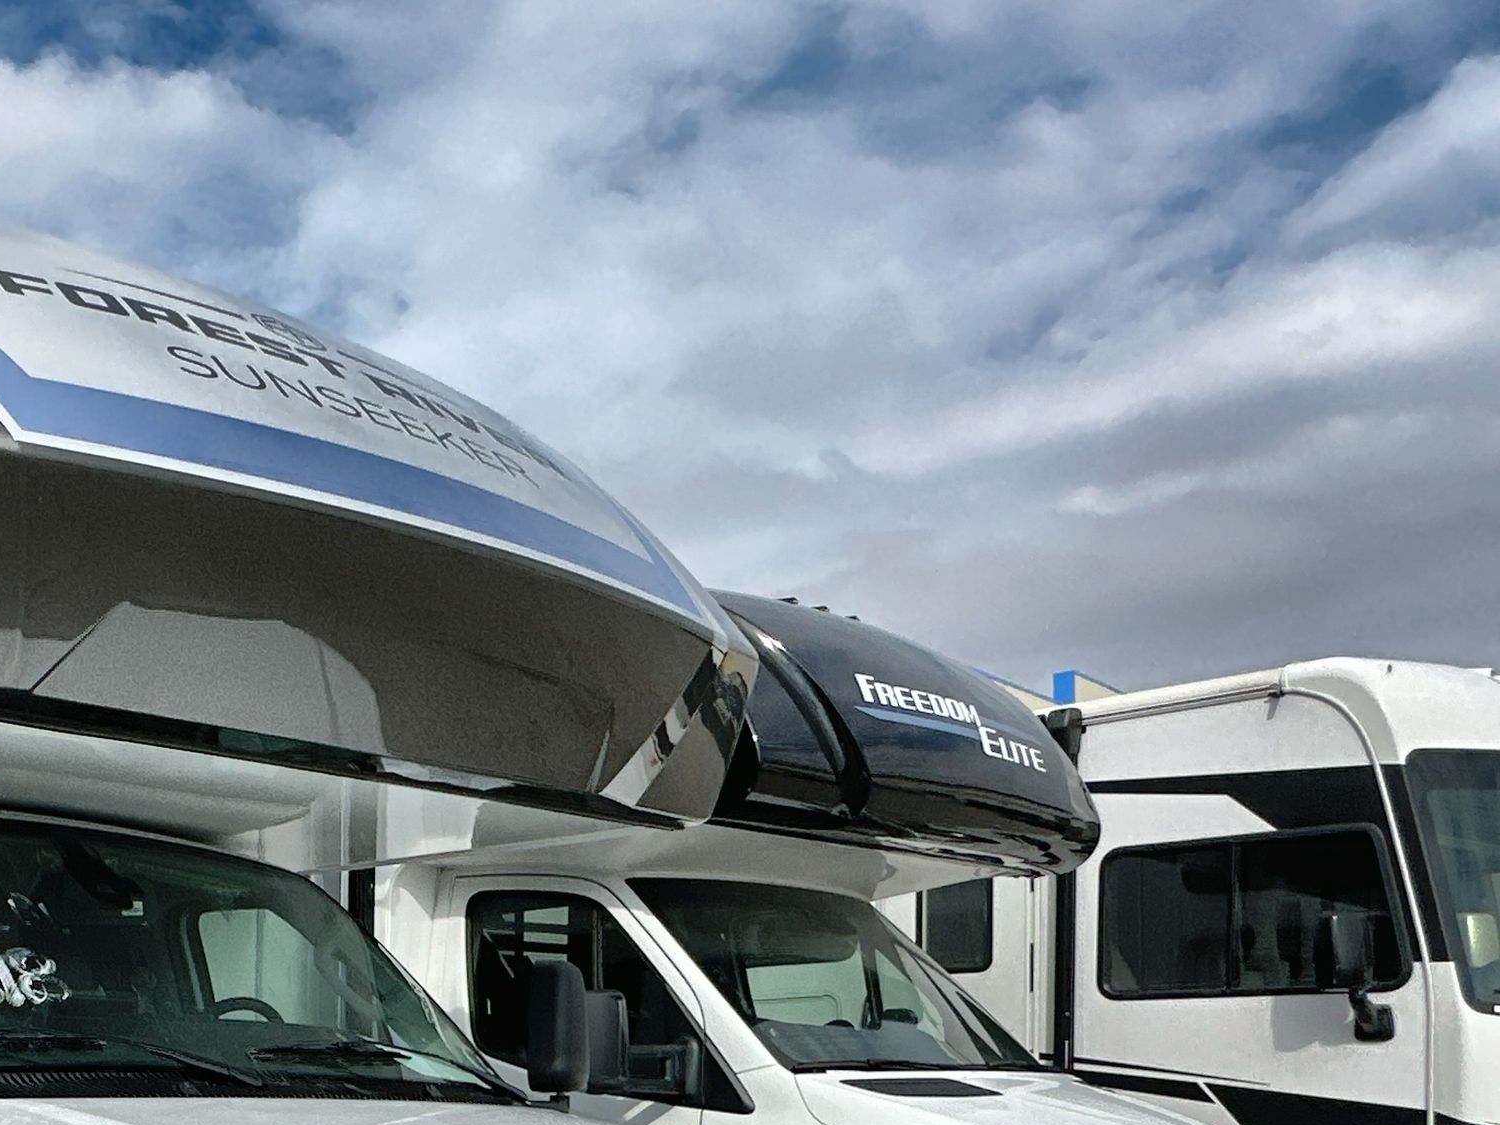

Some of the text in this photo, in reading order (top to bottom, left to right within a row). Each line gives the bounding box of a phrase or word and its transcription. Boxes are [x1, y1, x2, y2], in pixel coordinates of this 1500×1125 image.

[166, 346, 540, 490] SUNSEEKER
[854, 672, 982, 728] FREEDOM
[978, 725, 1047, 773] ELITE
